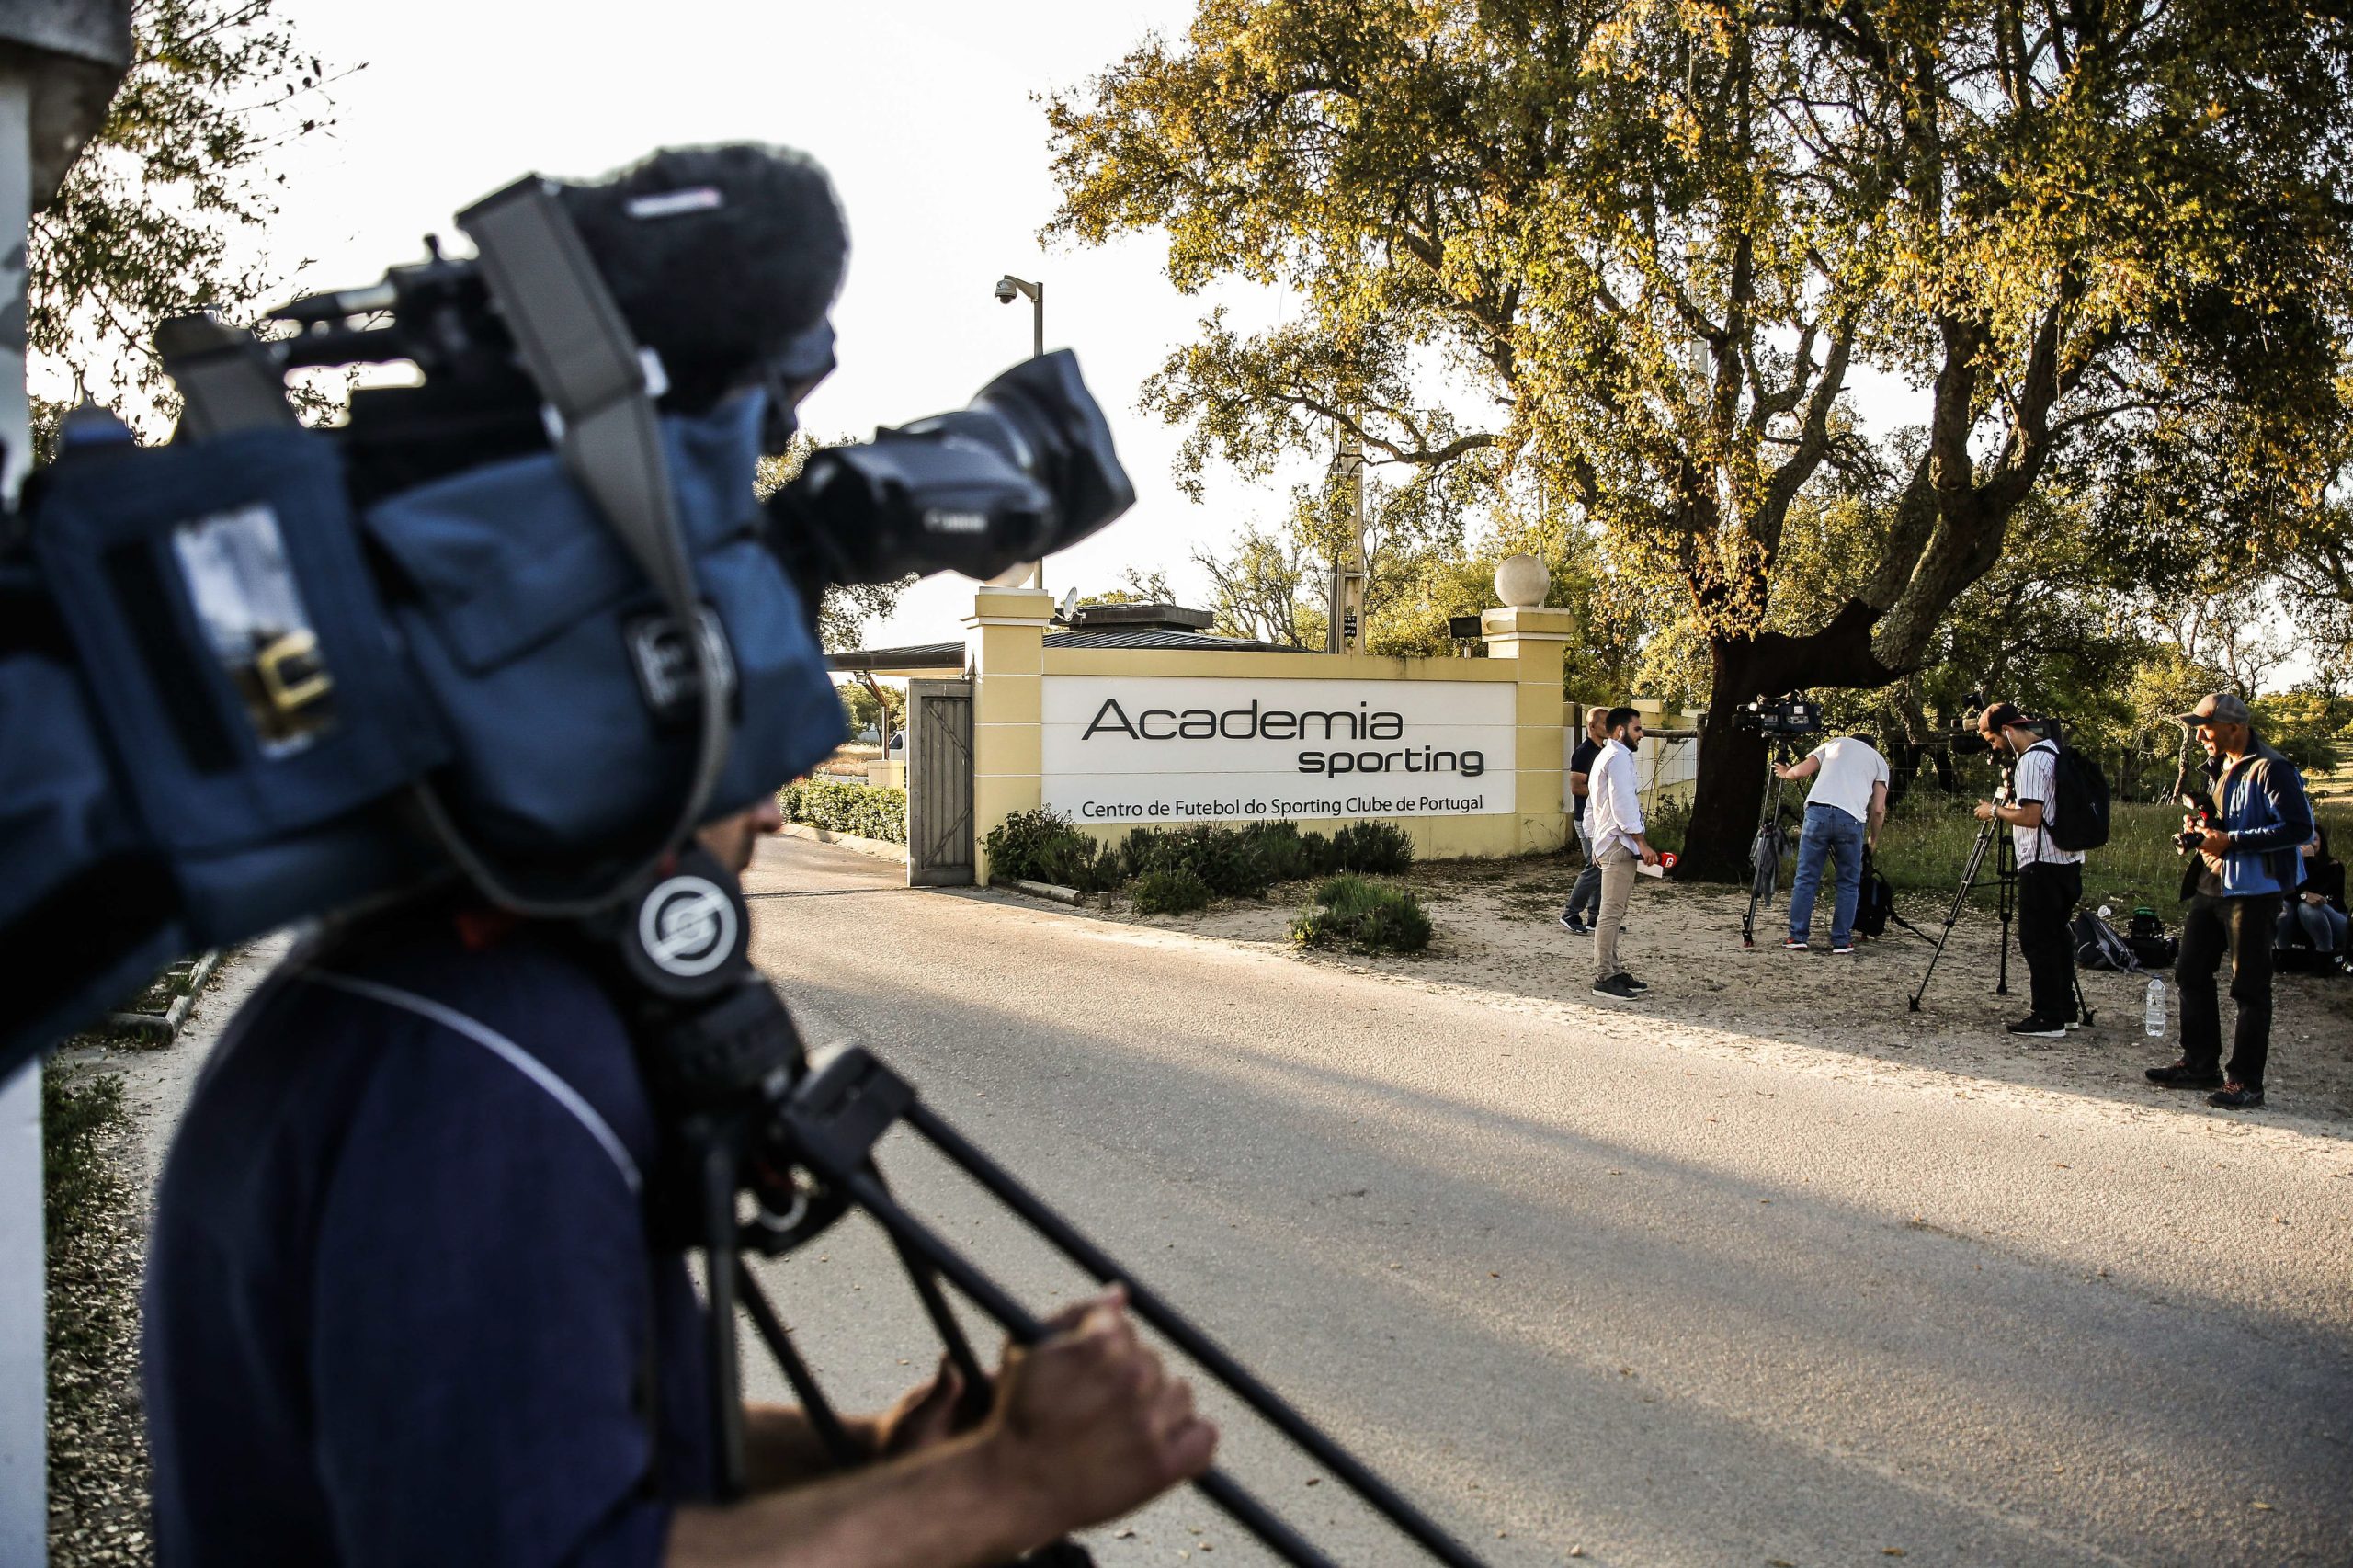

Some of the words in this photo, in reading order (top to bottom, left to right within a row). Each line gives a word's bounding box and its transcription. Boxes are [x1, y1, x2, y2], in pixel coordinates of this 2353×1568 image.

[1081, 699, 1404, 741] Academia
[1298, 744, 1485, 779] sporting
[1082, 801, 1143, 818] Centro
[1147, 799, 1171, 816] de
[1175, 798, 1240, 816] Futebol
[1244, 798, 1267, 814] do
[1270, 798, 1342, 818] Sporting
[1346, 796, 1392, 812] Clube
[1395, 795, 1415, 812] de
[1419, 794, 1483, 814] Portugal
